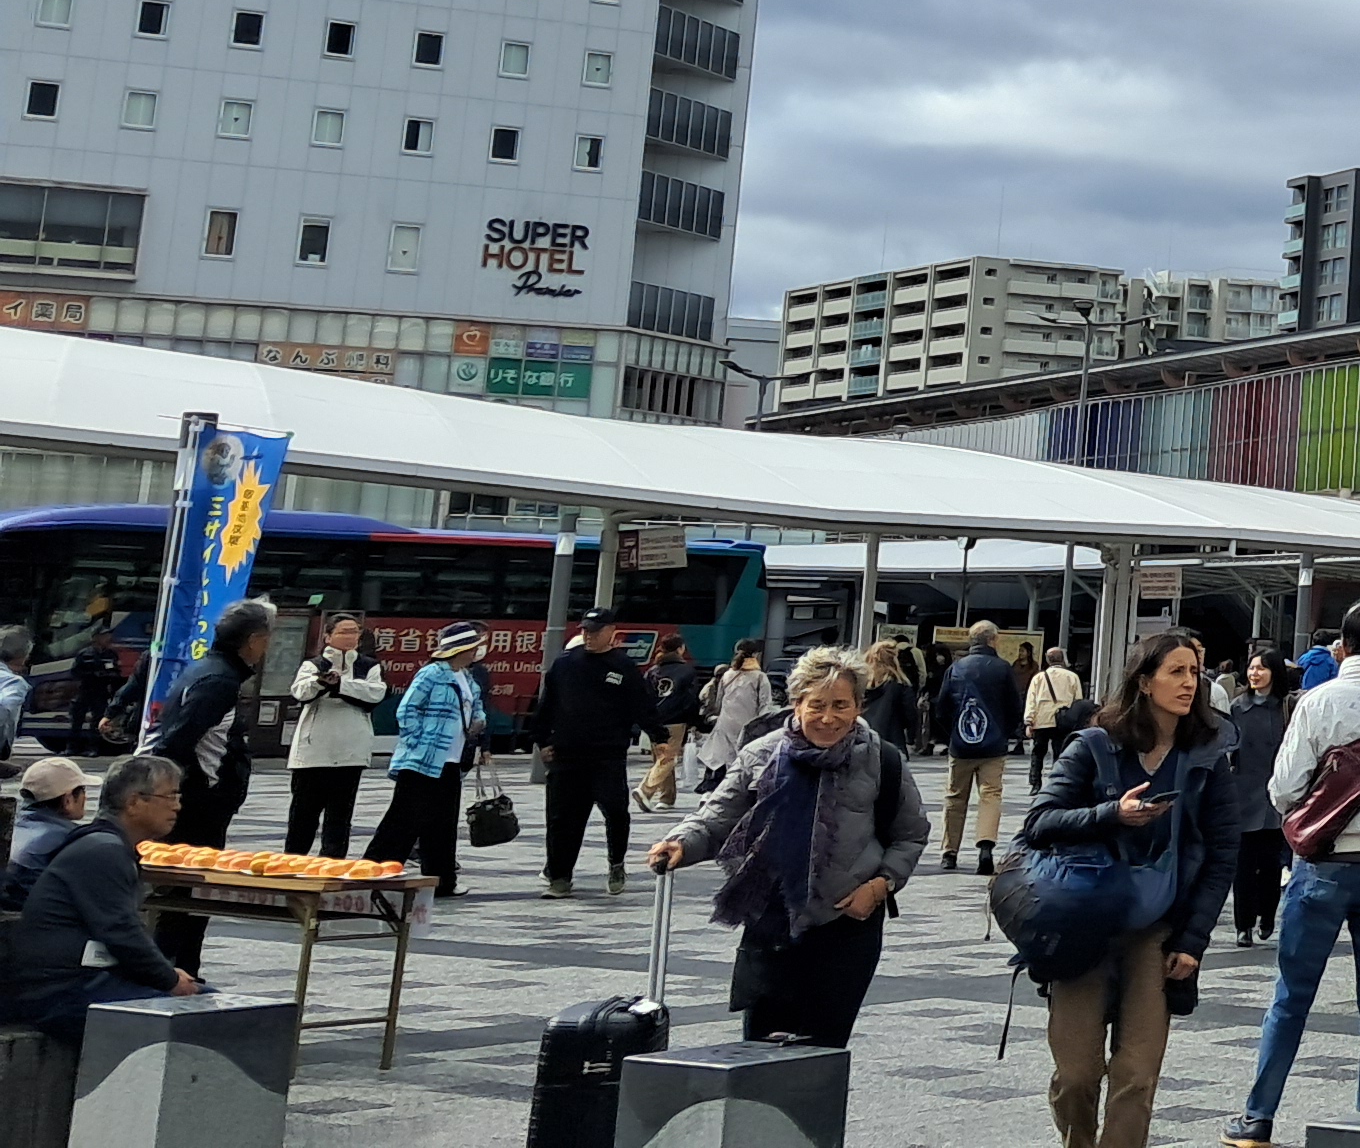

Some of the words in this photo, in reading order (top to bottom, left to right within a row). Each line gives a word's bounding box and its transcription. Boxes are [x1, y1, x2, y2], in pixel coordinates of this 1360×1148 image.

[485, 218, 590, 250] SUPER
[481, 243, 586, 275] HOTEL
[3, 299, 86, 324] イ薬局
[490, 367, 575, 389] りそな銀行
